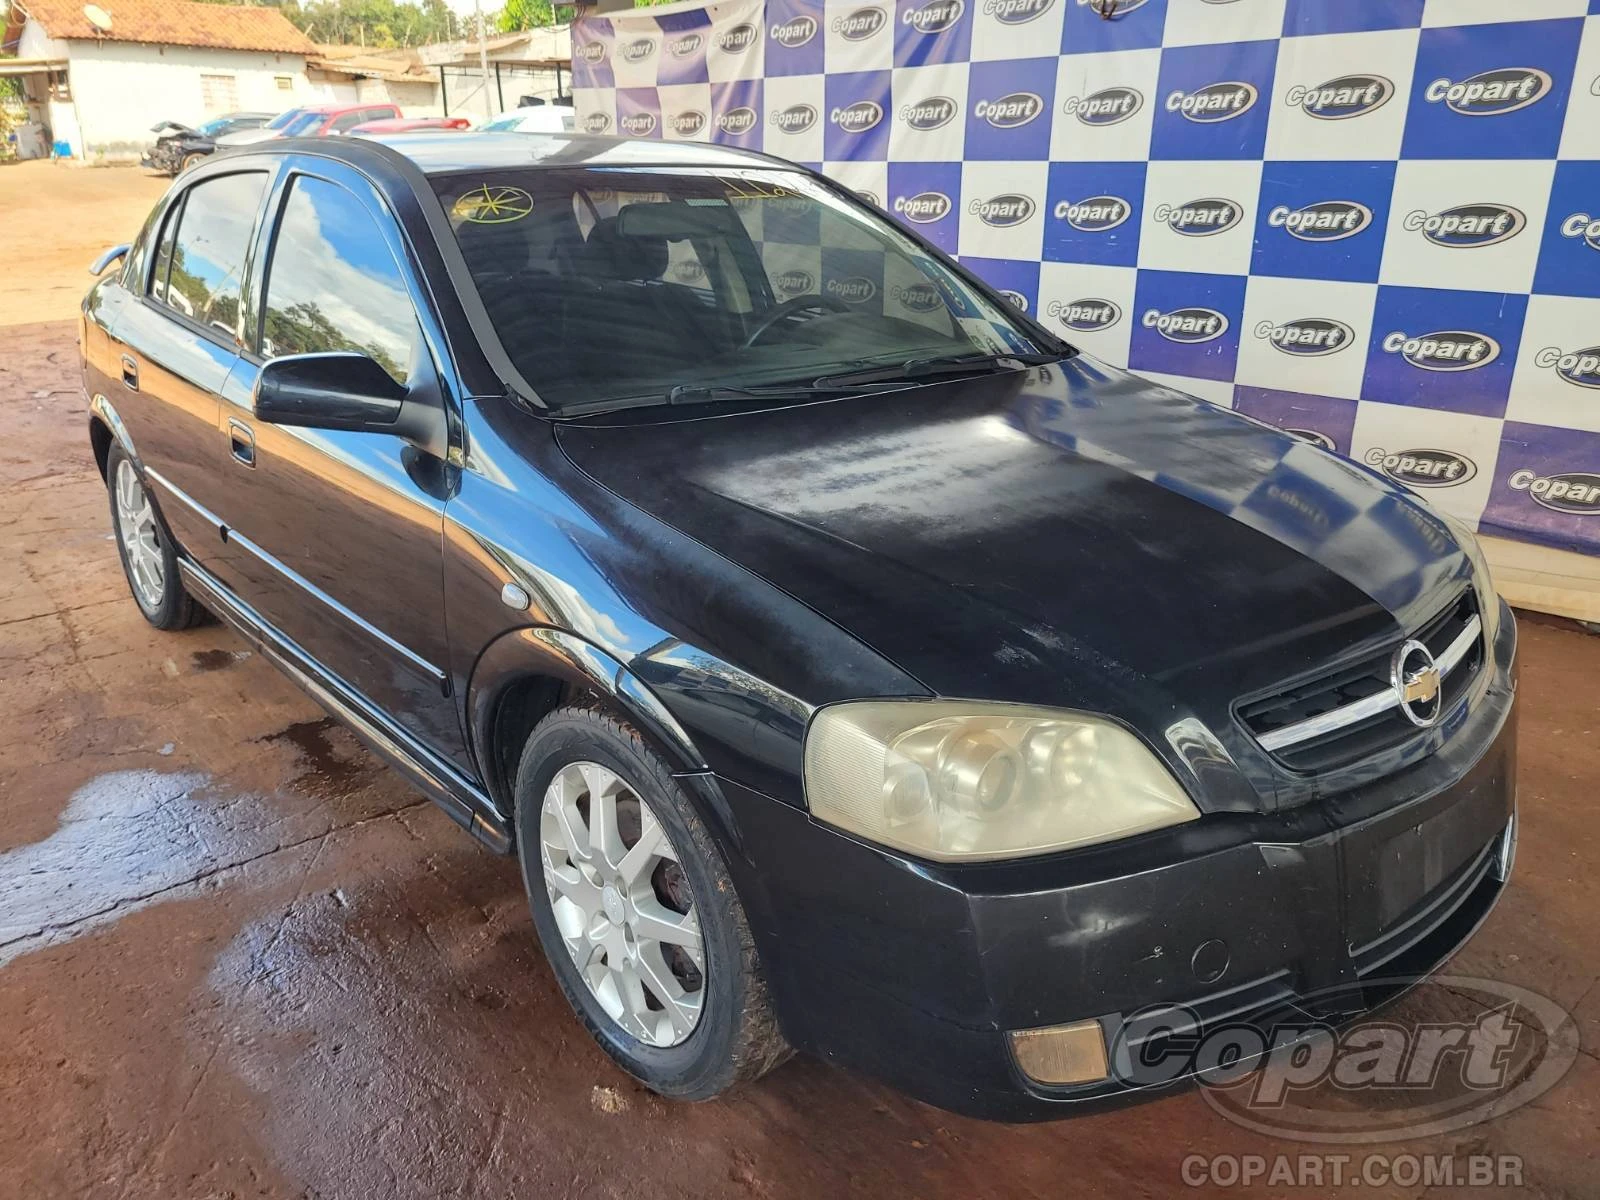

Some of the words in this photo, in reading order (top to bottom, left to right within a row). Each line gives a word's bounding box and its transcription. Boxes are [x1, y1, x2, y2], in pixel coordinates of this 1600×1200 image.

[831, 12, 879, 34] Copart
[903, 3, 958, 26] Copart
[770, 20, 811, 41] Copart
[575, 44, 602, 58] Copart
[1166, 86, 1246, 114] Copart
[1285, 81, 1380, 109] Copart
[1425, 75, 1537, 104] Copart
[770, 108, 811, 127] Copart
[830, 106, 876, 126] Copart
[899, 102, 948, 123] Copart
[974, 98, 1035, 120] Copart
[1064, 94, 1131, 118] Copart
[621, 115, 652, 131] Copart
[667, 113, 700, 131] Copart
[714, 111, 751, 129] Copart
[895, 196, 945, 217] Copart
[968, 198, 1027, 218] Copart
[1054, 200, 1122, 225] Copart
[1154, 203, 1233, 228] Copart
[1268, 206, 1361, 233] Copart
[1403, 209, 1509, 237] Copart
[826, 278, 870, 299] Copart
[1048, 301, 1112, 326] Copart
[1142, 308, 1223, 337] Copart
[1254, 320, 1345, 350] Copart
[1383, 331, 1486, 362] Copart
[1535, 347, 1600, 377] Cop
[1364, 447, 1464, 481] Copart
